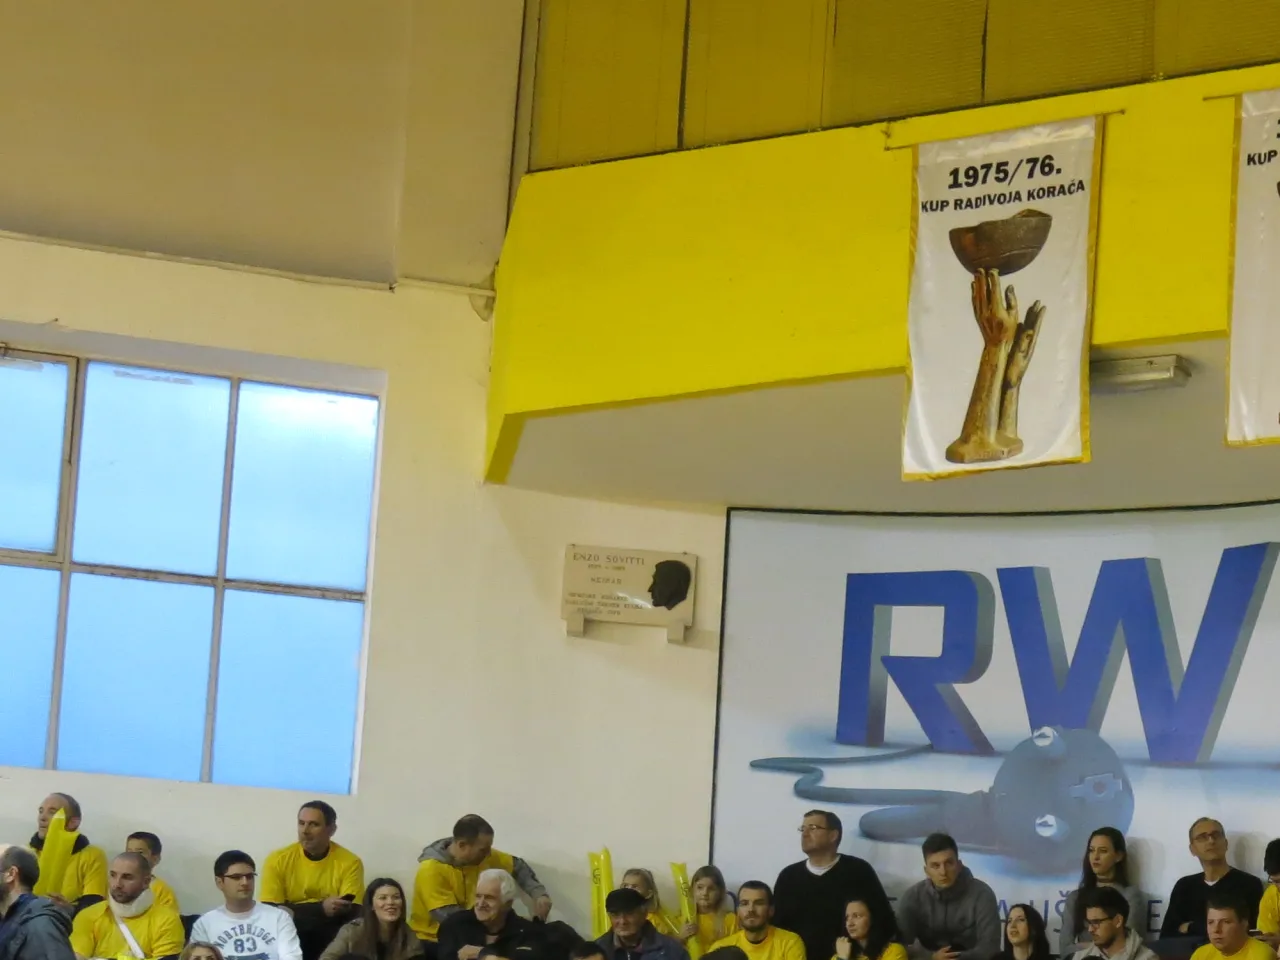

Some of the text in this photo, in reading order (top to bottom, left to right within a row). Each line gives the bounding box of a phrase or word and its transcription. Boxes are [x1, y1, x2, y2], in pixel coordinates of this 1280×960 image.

[1247, 149, 1278, 166] KUP
[948, 154, 1062, 190] 1975/76.
[921, 200, 950, 213] KUP
[954, 189, 1023, 211] RADIVOJA
[573, 552, 600, 562] ENZO
[233, 936, 257, 954] 83
